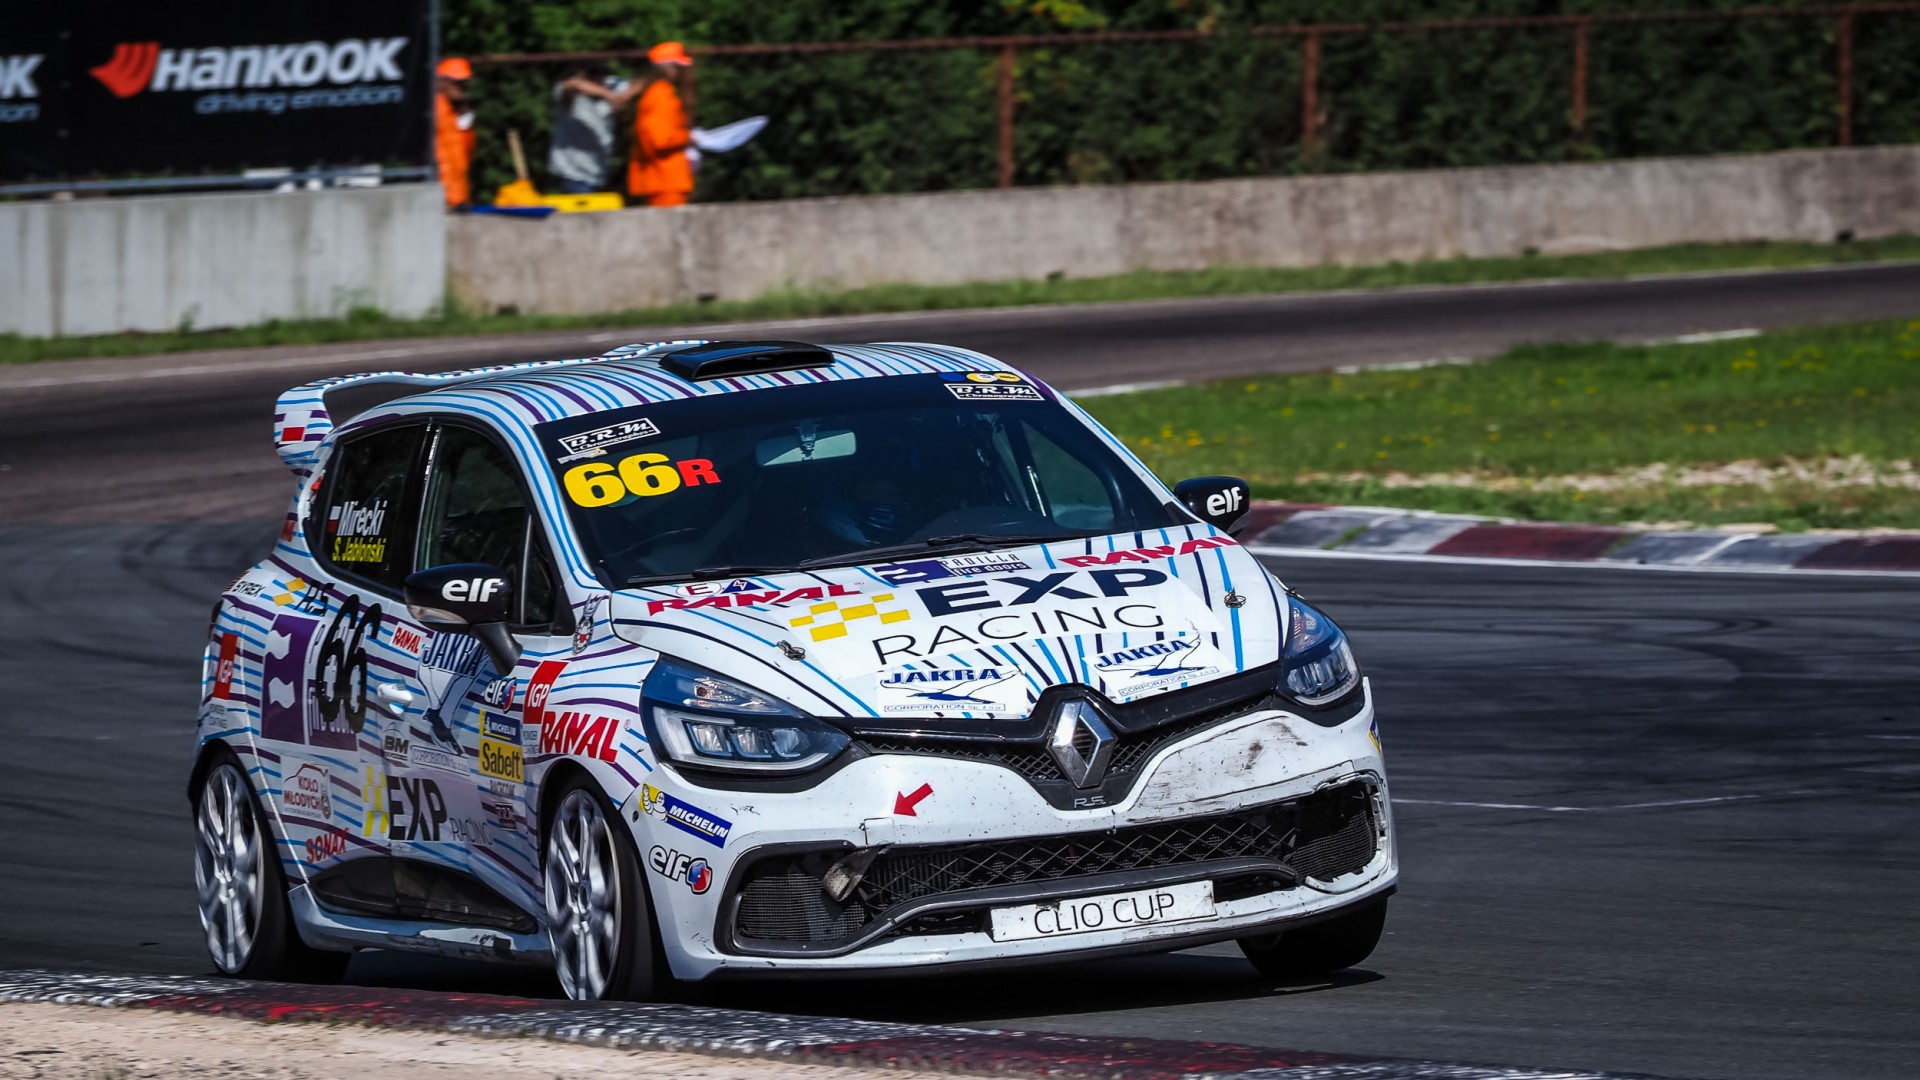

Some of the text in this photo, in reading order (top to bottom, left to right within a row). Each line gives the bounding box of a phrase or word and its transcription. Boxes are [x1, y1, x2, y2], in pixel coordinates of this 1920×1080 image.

[196, 86, 403, 115] driving emotion
[336, 500, 388, 536] Mirecki
[1206, 486, 1243, 516] elf
[953, 562, 1028, 576] fire doors
[441, 578, 502, 603] elf
[647, 584, 863, 616] RANAL
[915, 568, 1169, 617] EXP
[871, 604, 1165, 665] RACING
[316, 593, 382, 734] 66
[422, 631, 486, 677] JAKRA
[1097, 639, 1194, 668] JAKRA
[484, 679, 507, 705] elf
[883, 667, 1003, 684] JAKRA
[526, 683, 549, 708] IGP
[384, 735, 410, 754] BM
[538, 711, 621, 763] RANAL
[481, 741, 521, 780] Sabelt
[387, 775, 448, 841] EXP
[668, 804, 729, 839] MICHELIN
[306, 827, 350, 865] SONAX
[449, 816, 493, 846] RACING
[650, 845, 690, 882] elf
[1034, 892, 1176, 935] CLIO CUP
